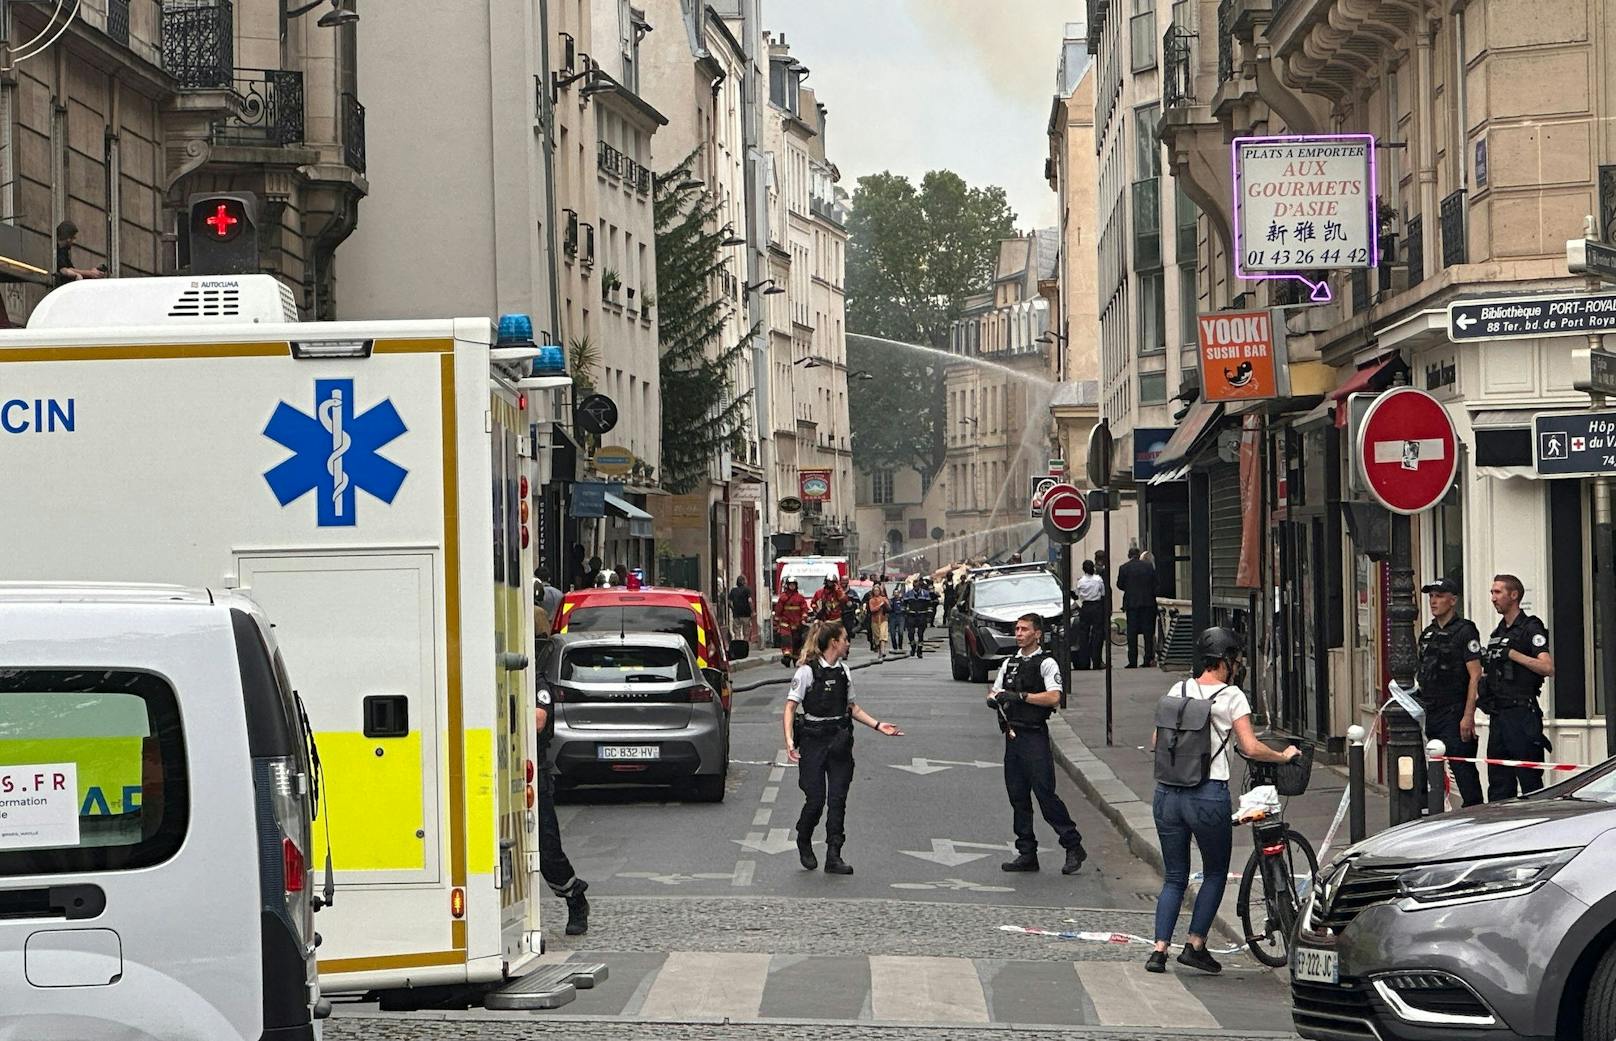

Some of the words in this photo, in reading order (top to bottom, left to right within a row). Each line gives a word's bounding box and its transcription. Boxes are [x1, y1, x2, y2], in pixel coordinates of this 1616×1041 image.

[1245, 149, 1283, 159] PLATS
[1286, 150, 1294, 158] A
[1298, 147, 1364, 158] EMPORTER
[1282, 160, 1327, 177] AUX
[1248, 180, 1361, 198] GOURMETS
[1274, 200, 1339, 218] D'ASIE
[1266, 219, 1348, 246] 新雅凯
[1248, 250, 1265, 266] 01
[1271, 250, 1290, 265] 43
[1295, 249, 1314, 265] 26
[1320, 248, 1341, 264] 44
[1347, 248, 1367, 263] 42
[1480, 304, 1542, 320] Bibliothèque
[1201, 316, 1269, 346] YOOKI
[1486, 322, 1501, 333] 88
[1525, 320, 1541, 331] bd.
[1543, 319, 1557, 329] de
[1560, 317, 1584, 328] Port
[1206, 345, 1240, 361] SUSHI
[1243, 344, 1267, 358] BAR
[1589, 436, 1604, 449] du
